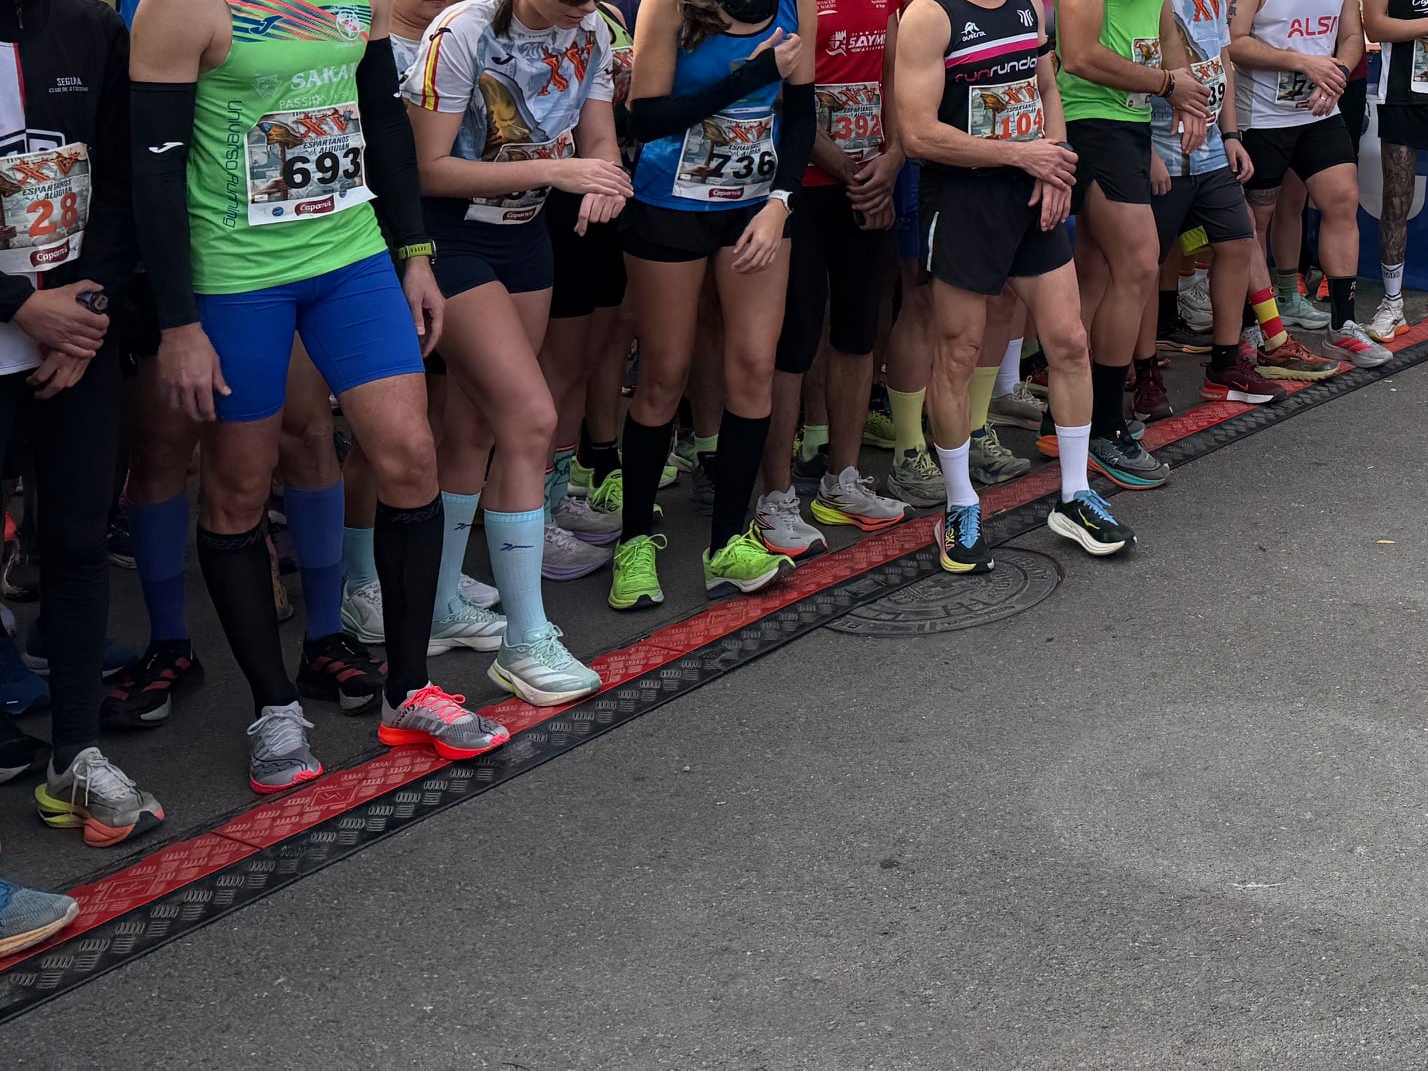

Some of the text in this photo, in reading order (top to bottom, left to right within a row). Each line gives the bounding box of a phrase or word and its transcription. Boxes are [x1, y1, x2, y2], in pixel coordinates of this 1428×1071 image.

[834, 113, 881, 140] 392
[1000, 108, 1044, 140] 104
[303, 135, 350, 149] ESPARTANOS
[283, 147, 361, 189] 693
[710, 150, 775, 179] 736
[26, 191, 78, 238] 28
